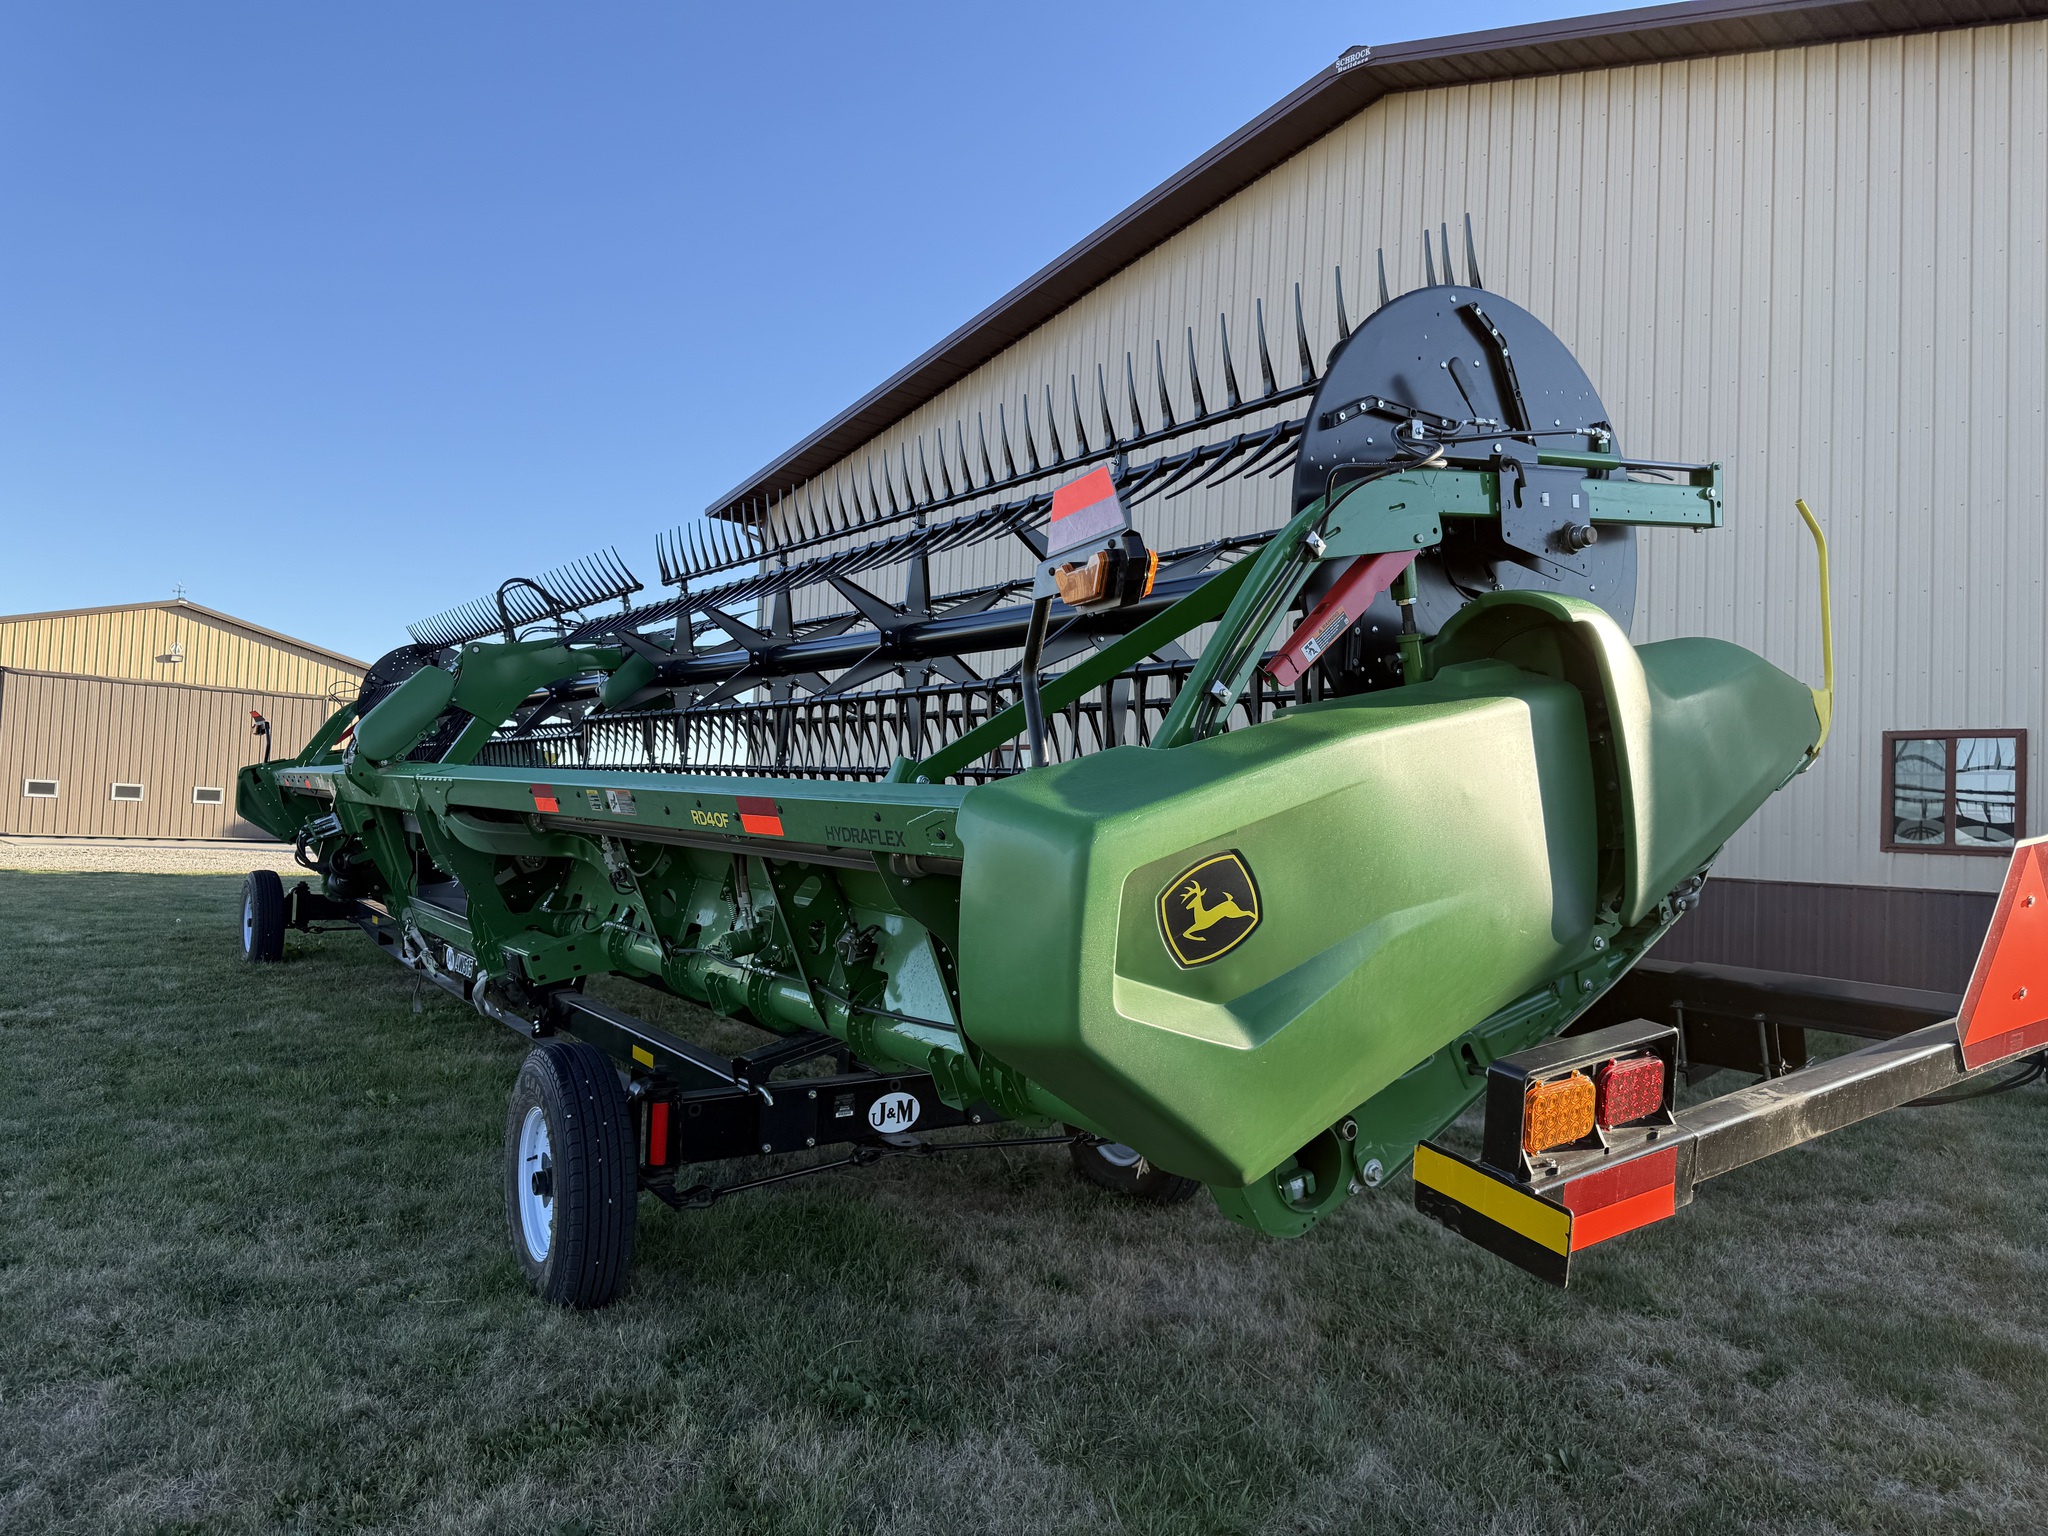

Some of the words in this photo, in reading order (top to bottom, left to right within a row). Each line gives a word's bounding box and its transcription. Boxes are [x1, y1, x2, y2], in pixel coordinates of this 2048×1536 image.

[1336, 48, 1371, 68] SCHROCK
[690, 809, 729, 828] RD40F
[825, 825, 906, 847] HYDRAFLEX
[872, 1098, 915, 1126] J&M
